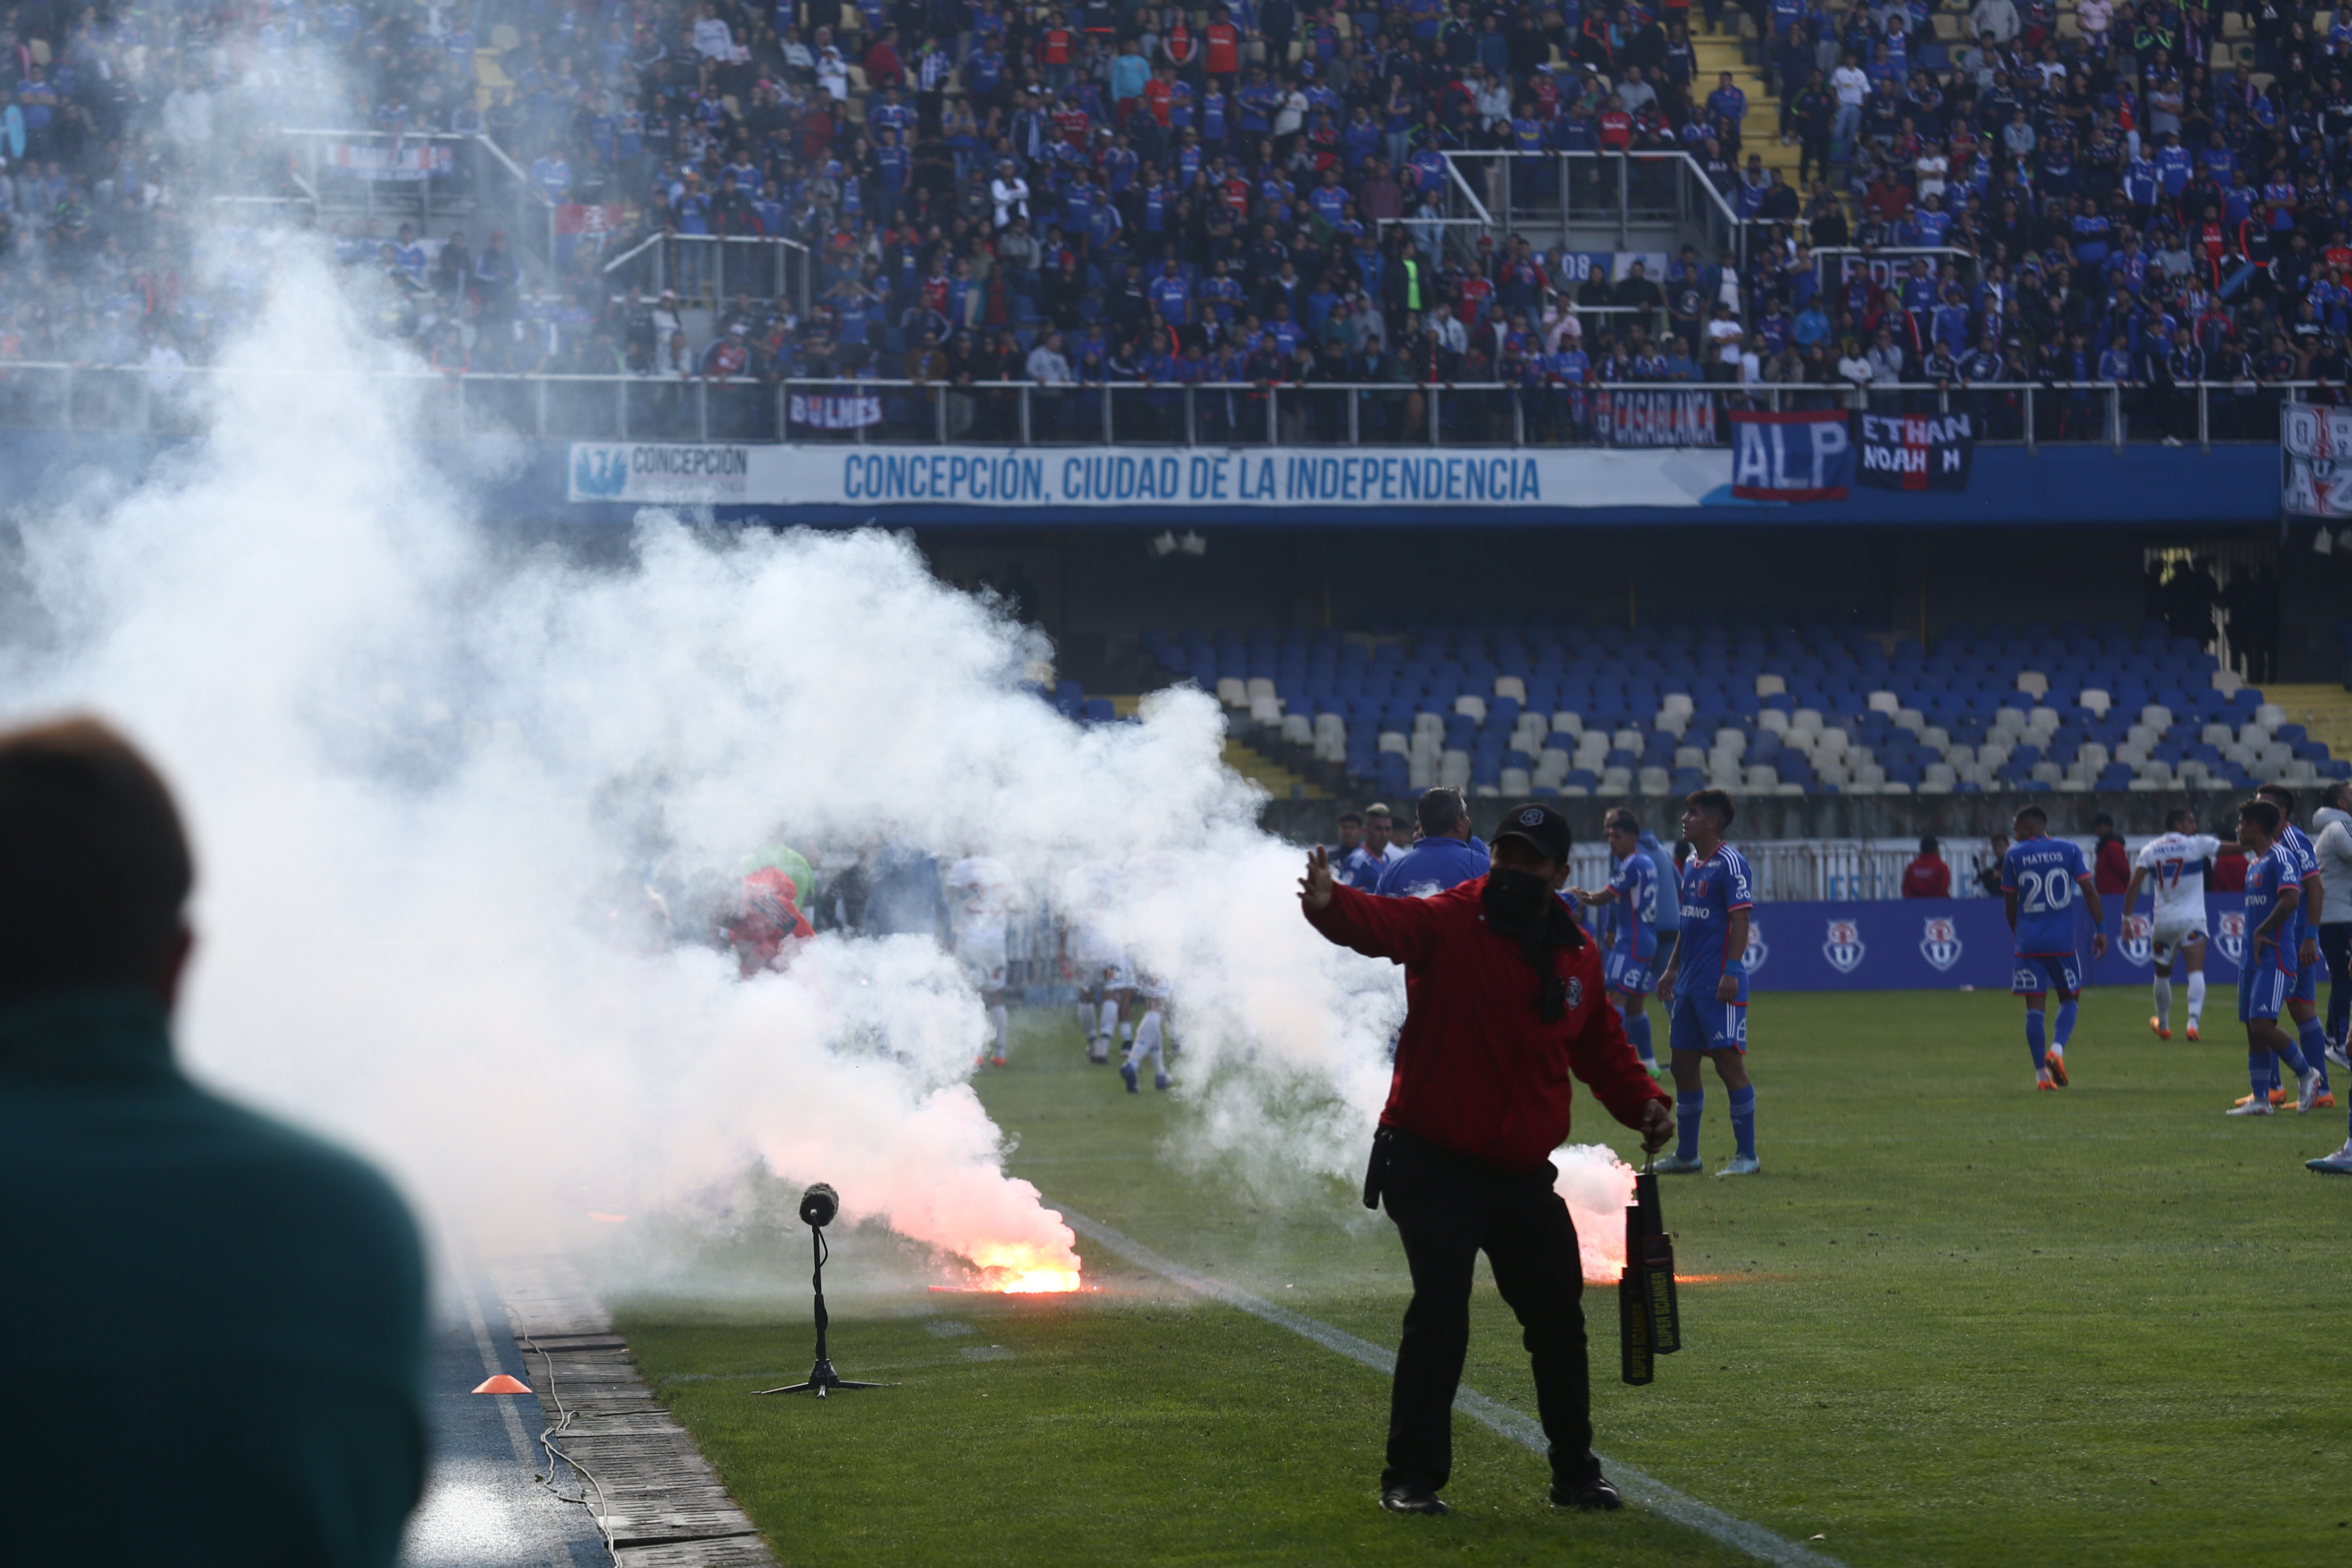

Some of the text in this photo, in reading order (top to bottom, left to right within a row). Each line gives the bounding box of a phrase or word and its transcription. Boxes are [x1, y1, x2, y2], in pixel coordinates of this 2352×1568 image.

[1862, 412, 1972, 445] ETHAN
[1736, 422, 1847, 488] ALP
[1864, 444, 1927, 473] NOAH
[844, 449, 1540, 503] CONCEPCIÓN, CIUDAD DE LA INDEPENDENCIA
[2022, 851, 2063, 867] MATEOS
[2155, 857, 2184, 891] 17
[2018, 867, 2071, 913] 20
[1651, 1272, 1674, 1347] SUPER SCANNER
